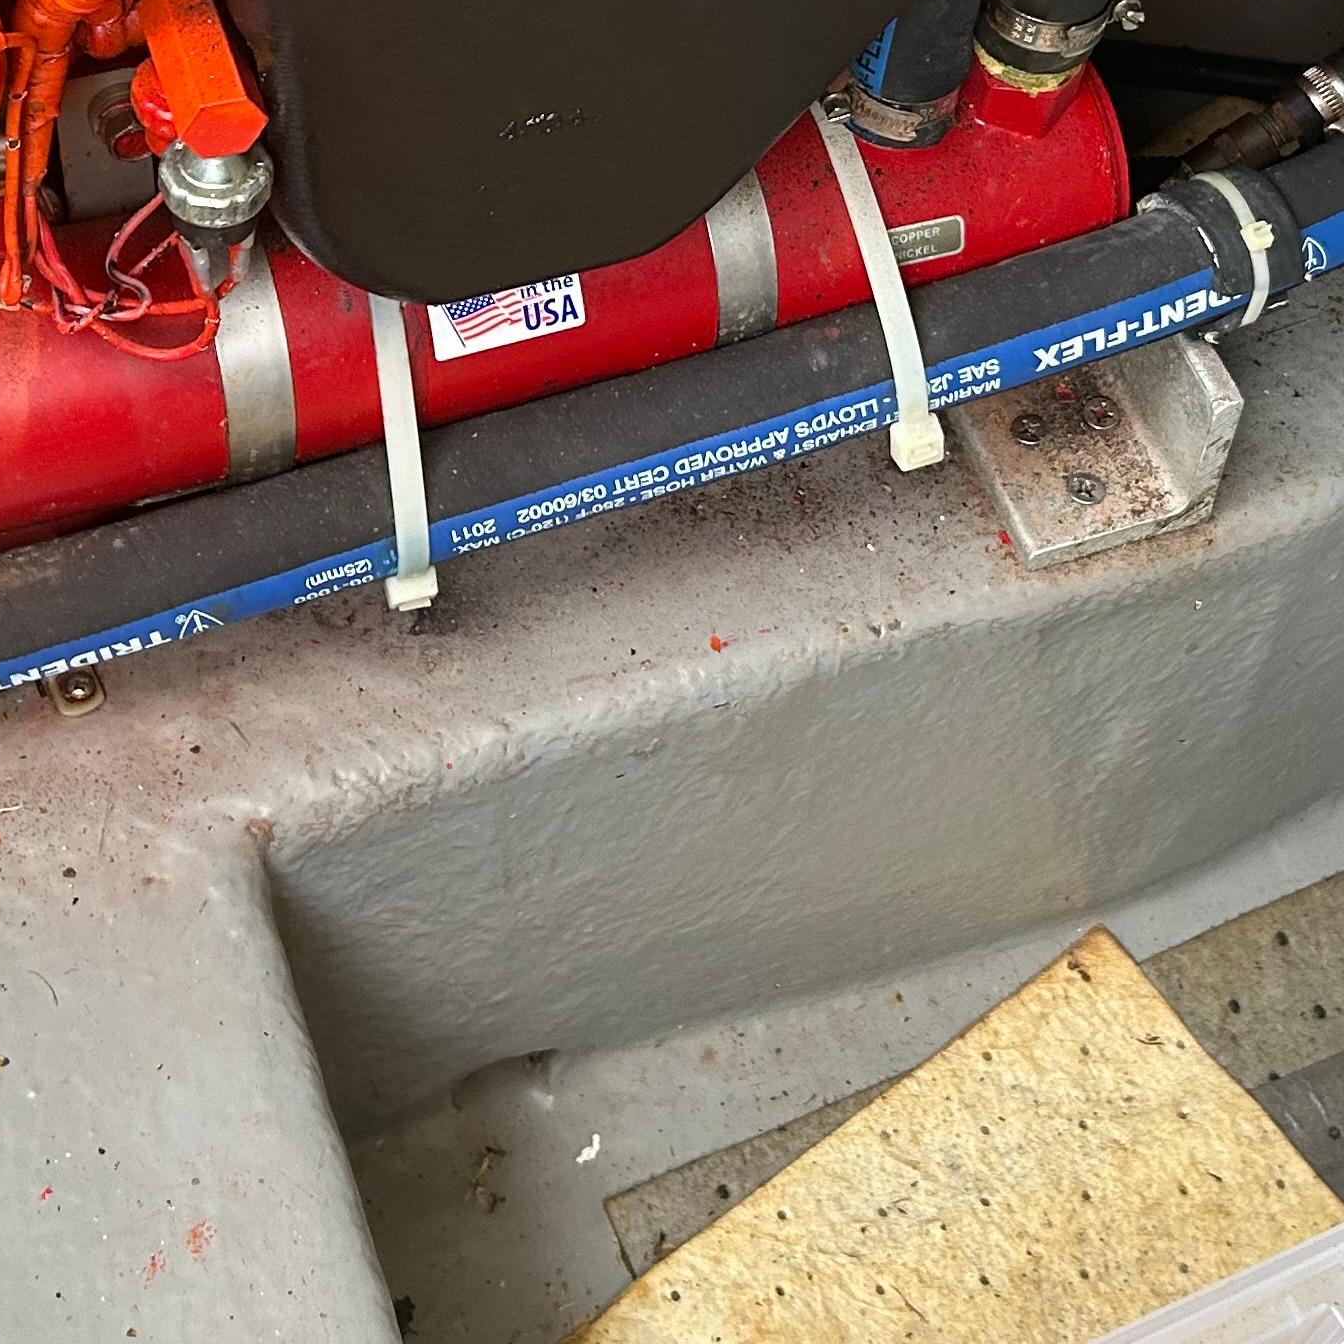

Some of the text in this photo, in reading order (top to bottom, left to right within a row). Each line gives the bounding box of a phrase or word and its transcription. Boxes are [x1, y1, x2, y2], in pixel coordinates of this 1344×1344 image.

[891, 226, 941, 246] COPPER
[543, 275, 574, 293] the
[523, 294, 579, 330] USA
[1033, 288, 1240, 371] DENT-FLEX
[956, 357, 1001, 384] SAE
[926, 376, 1002, 409] MARINE
[792, 396, 880, 438] LLOYD'S
[879, 410, 900, 425] ET
[672, 426, 791, 475] APPROVED
[788, 417, 878, 455] EXHAUST
[699, 453, 767, 482] WATER
[771, 447, 787, 460] &
[609, 464, 670, 495] CERT
[639, 475, 695, 500] HOSE
[515, 482, 607, 524] 03/60002
[449, 517, 497, 543] 2011
[452, 535, 500, 554] MAX.
[303, 557, 373, 590] (25mm)
